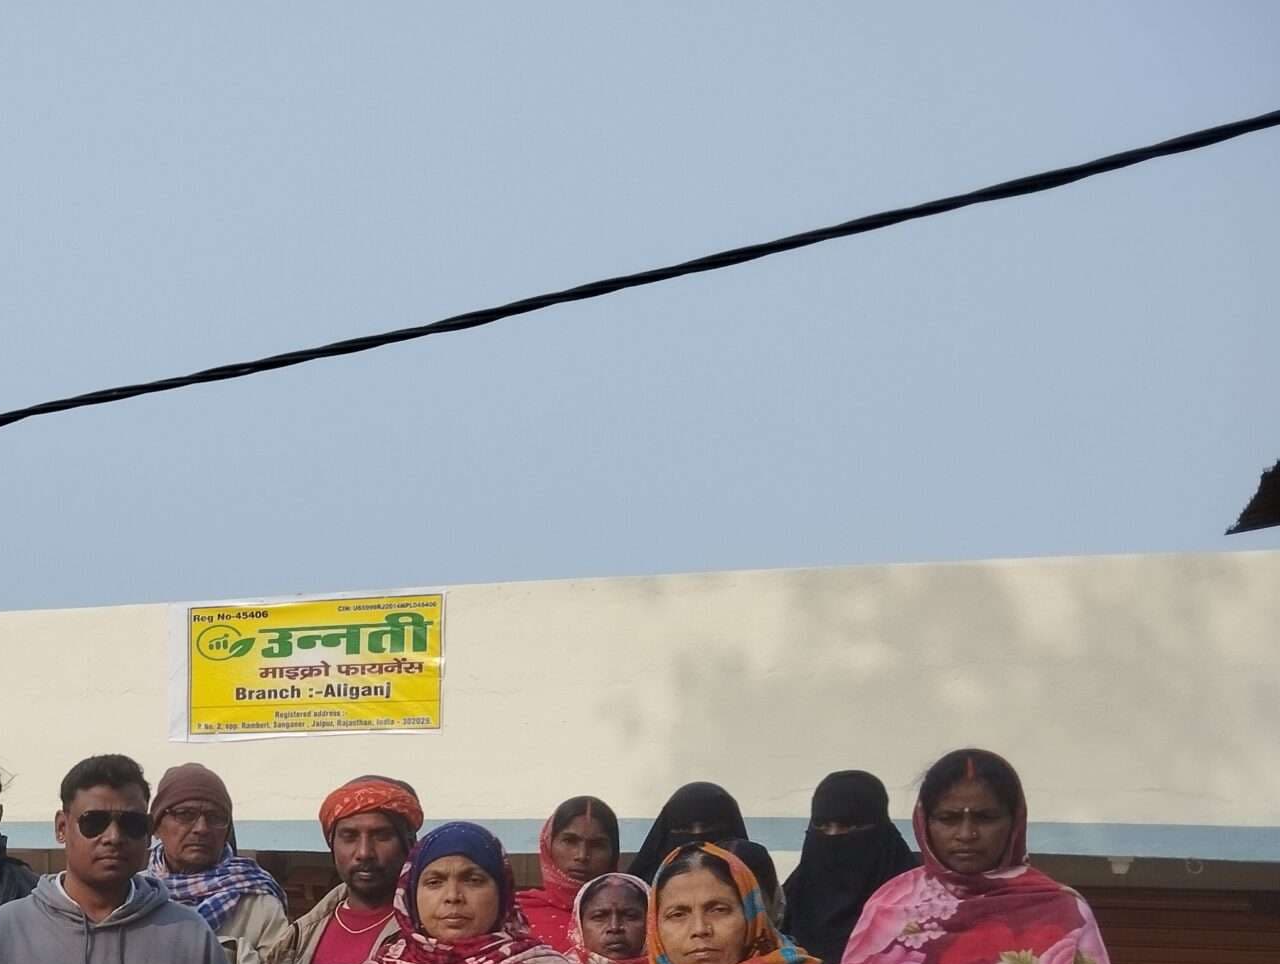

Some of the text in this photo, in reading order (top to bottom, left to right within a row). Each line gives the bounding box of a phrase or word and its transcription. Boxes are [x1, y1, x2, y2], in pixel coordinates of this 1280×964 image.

[193, 610, 269, 623] Reg No-45406
[258, 612, 434, 658] उन्नती
[259, 658, 425, 680] माइक्रो फायनेंस
[235, 684, 301, 701] Branch
[275, 710, 312, 719] Registered
[313, 709, 341, 717] address
